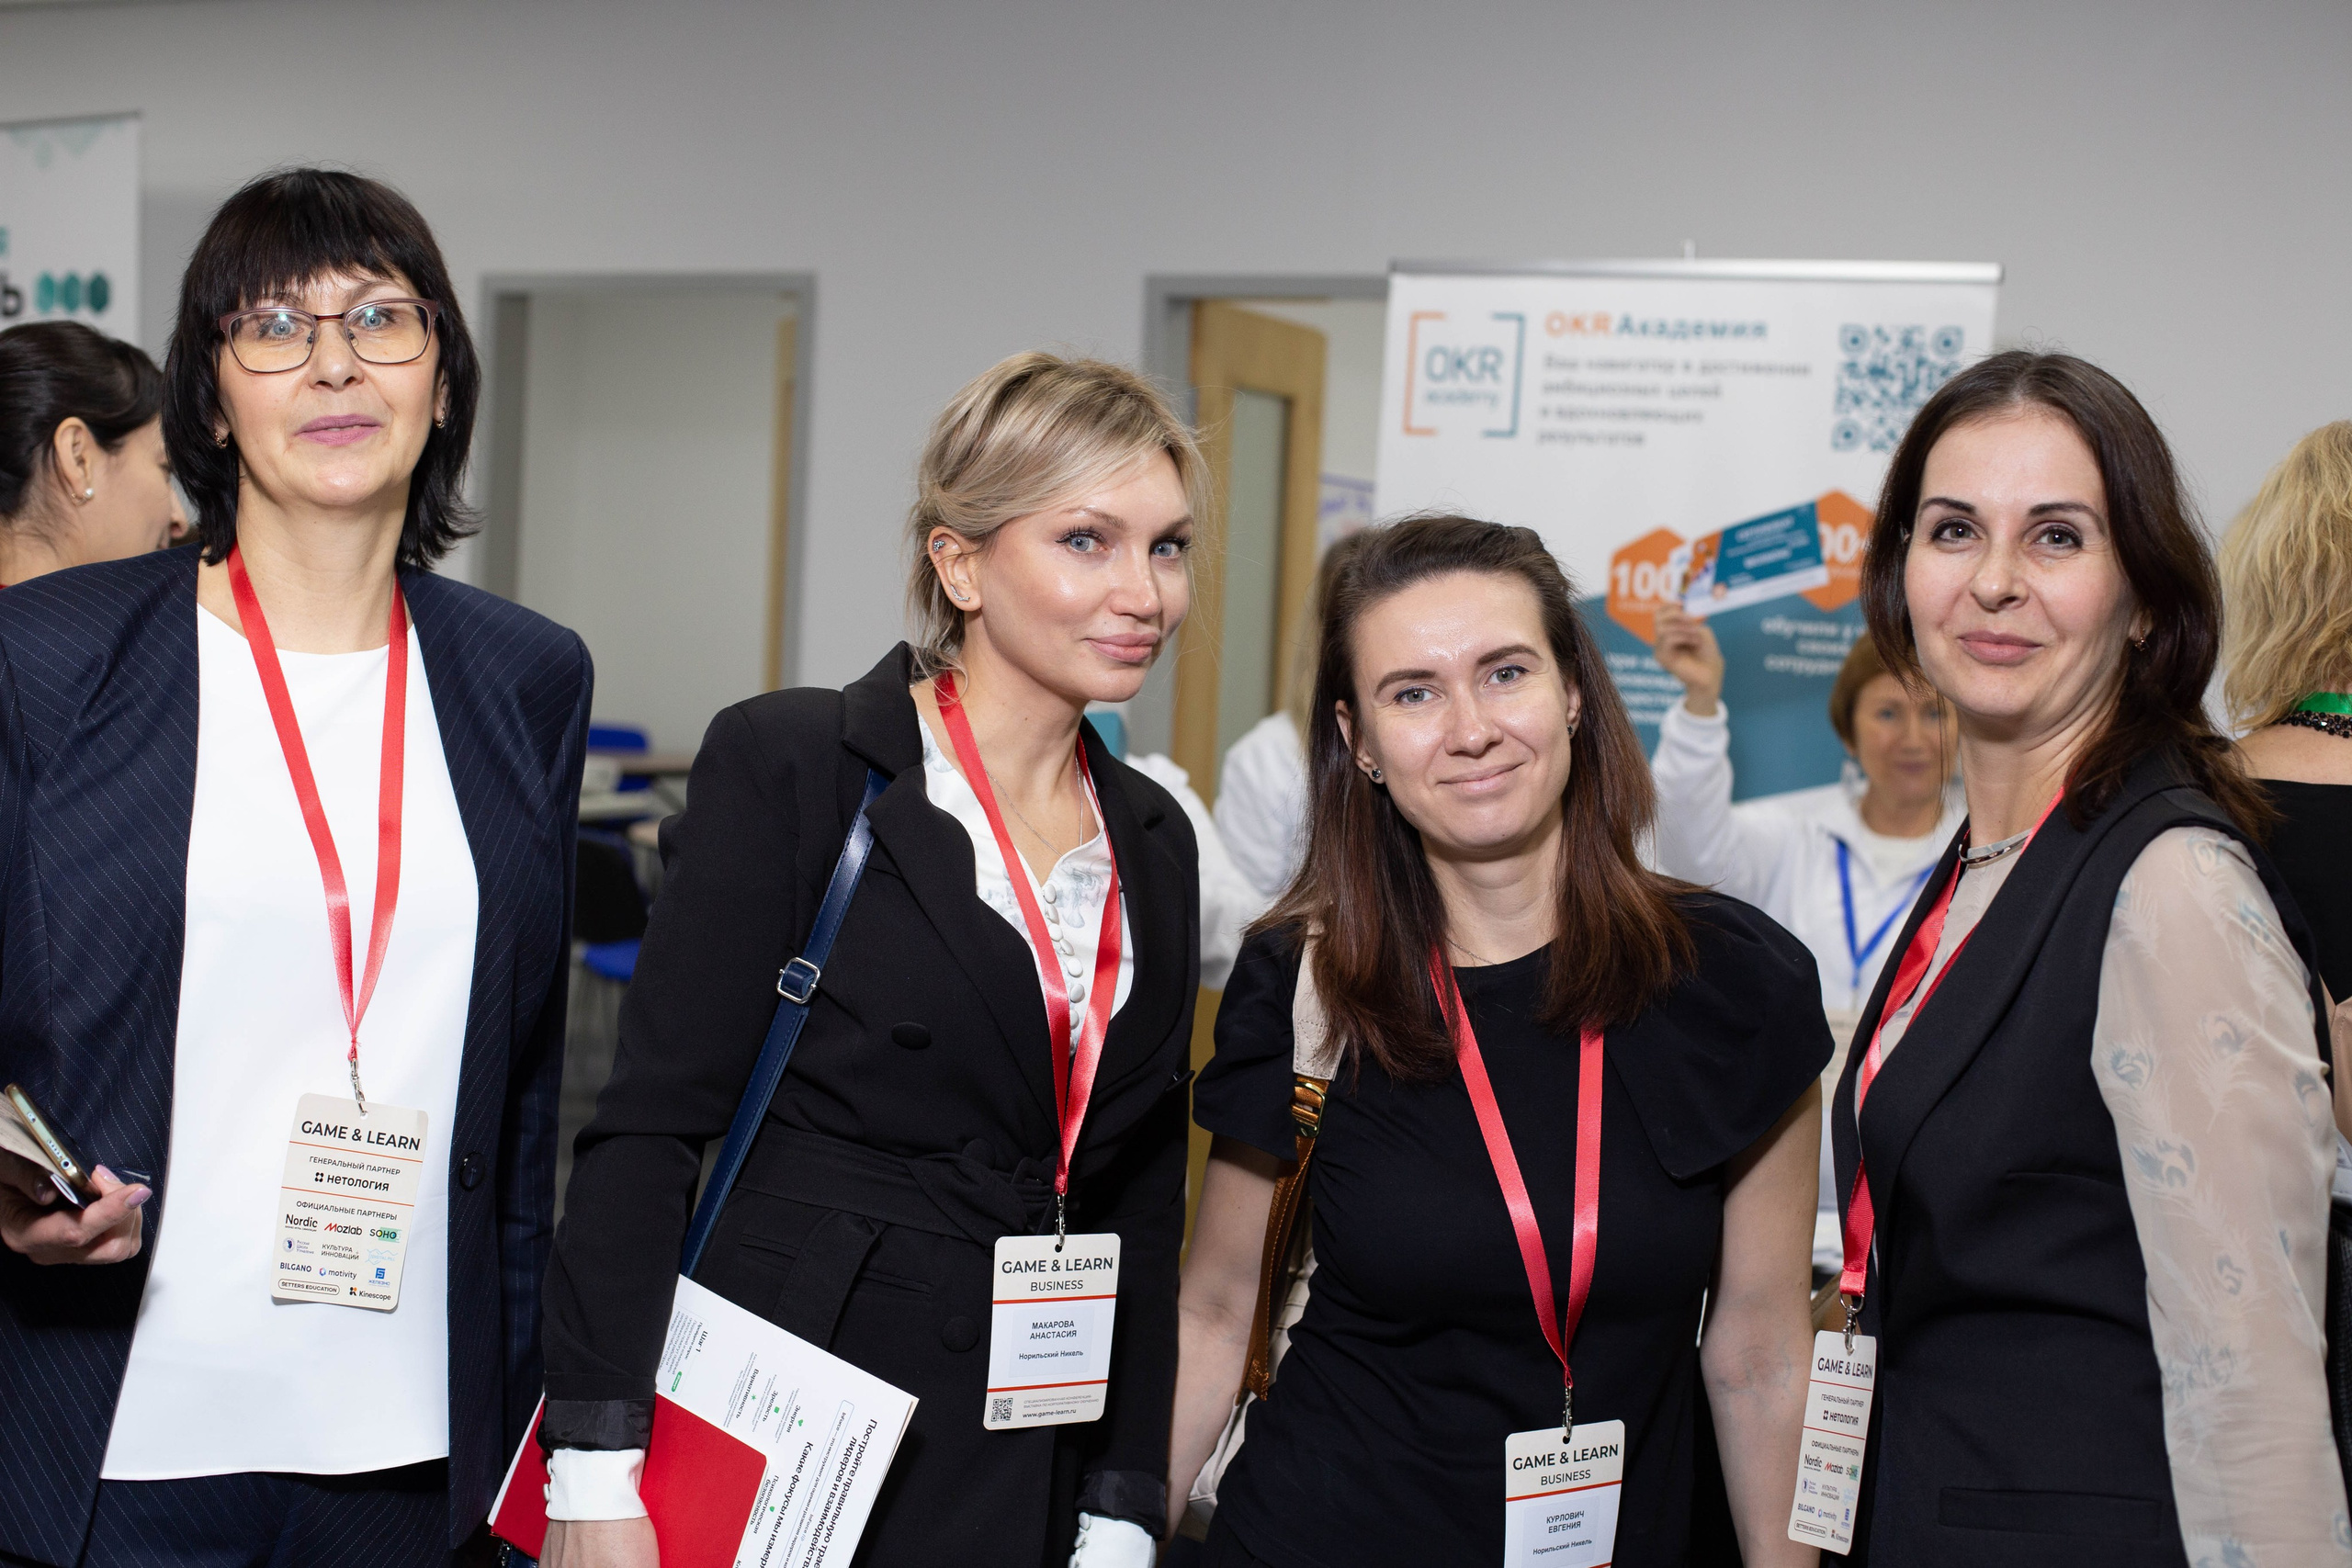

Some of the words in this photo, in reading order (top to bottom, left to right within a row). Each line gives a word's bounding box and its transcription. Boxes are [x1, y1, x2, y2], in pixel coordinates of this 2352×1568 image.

[1426, 346, 1504, 382] OKR
[300, 1120, 347, 1139] GAME
[351, 1127, 362, 1142] &
[367, 1130, 420, 1150] LEARN
[309, 1155, 364, 1170] ГЕНЕРАЛЬНЫЙ
[366, 1164, 400, 1175] ПАРТНЕР
[326, 1174, 389, 1191] нетология
[296, 1200, 355, 1215] ОФИЦИАЛЬНЫЕ
[356, 1209, 397, 1221] ПАРТНЕРЫ
[285, 1213, 318, 1228] Nordic
[323, 1221, 362, 1235] Mozlab
[369, 1228, 397, 1239] SOHO
[322, 1243, 352, 1253] КУЛЬТУРА
[279, 1261, 311, 1273] BILGANO
[328, 1268, 356, 1280] motivity
[1002, 1259, 1046, 1274] GAME
[1051, 1258, 1061, 1271] &
[1066, 1258, 1114, 1271] LEARN
[281, 1280, 304, 1289] SETTERS
[305, 1284, 336, 1293] EDUCATION
[1031, 1280, 1083, 1292] BUSINESS
[358, 1290, 390, 1302] Kinescope
[1032, 1320, 1075, 1329] МАКАРОВА
[696, 1330, 708, 1348] Шаг
[1030, 1330, 1077, 1339] АНАСТАСИЯ
[1019, 1350, 1058, 1360] Норильский
[1816, 1357, 1843, 1373] GAME
[1844, 1361, 1850, 1374] &
[1851, 1362, 1873, 1378] LEARN
[734, 1368, 759, 1419] Вариативность
[761, 1389, 778, 1422] Зрелость
[1023, 1409, 1076, 1418] www.game-learn.ru
[785, 1404, 800, 1433] Энергия
[846, 1417, 877, 1478] Постройте
[795, 1440, 813, 1474] Какие
[832, 1436, 858, 1483] лидеров
[1513, 1453, 1555, 1471] GAME
[1560, 1451, 1569, 1464] &
[1574, 1444, 1619, 1462] LEARN
[1804, 1453, 1822, 1467] Nordic
[1541, 1470, 1591, 1486] BUSINESS
[777, 1472, 800, 1516] фокусы
[831, 1483, 839, 1492] и
[748, 1478, 771, 1525] безопасность
[751, 1474, 779, 1534] Психологическая
[820, 1476, 854, 1543] правильную
[772, 1515, 784, 1533] мы
[1546, 1510, 1585, 1524] КУРЛОВИЧ
[1548, 1521, 1581, 1533] ЕВГЕНИЯ
[1532, 1542, 1570, 1555] Норильский
[1570, 1539, 1592, 1548] Никель
